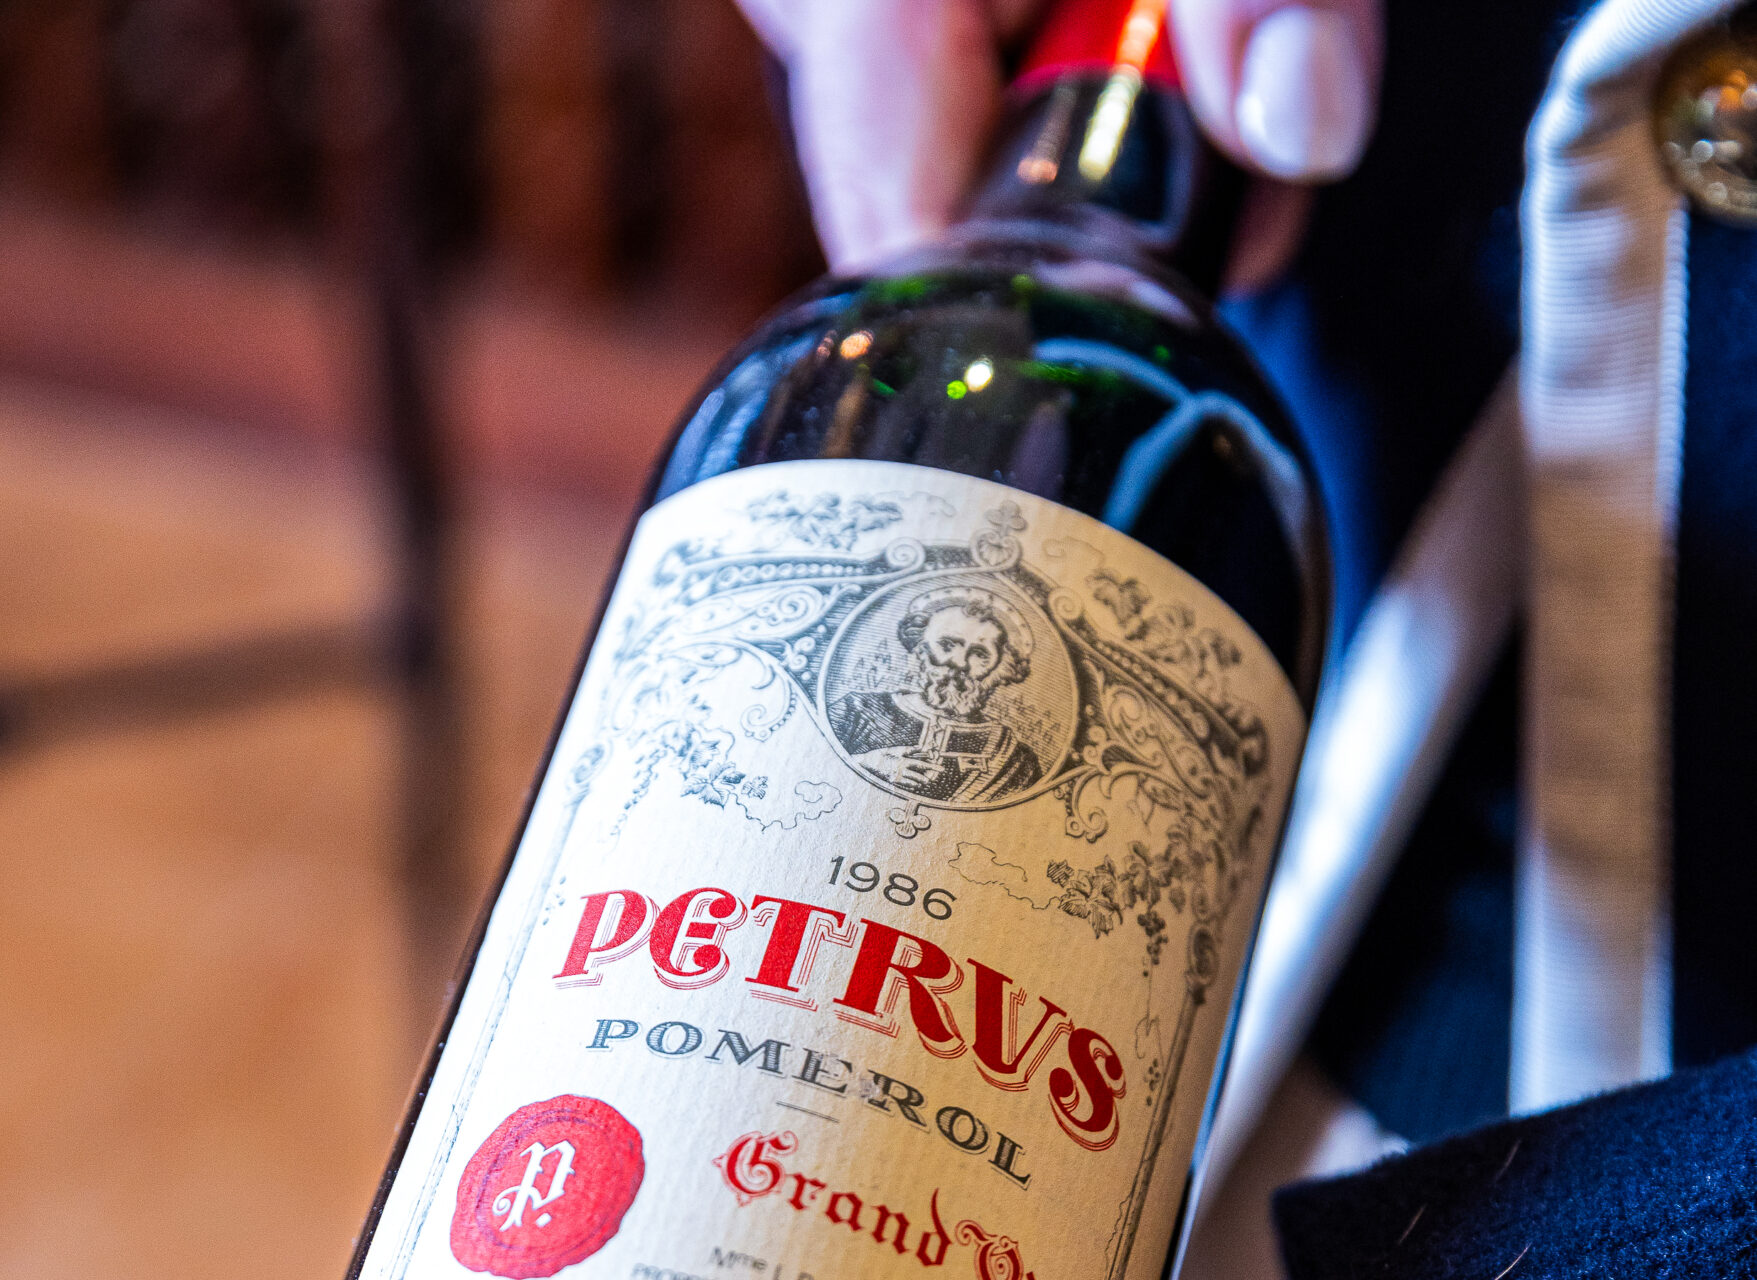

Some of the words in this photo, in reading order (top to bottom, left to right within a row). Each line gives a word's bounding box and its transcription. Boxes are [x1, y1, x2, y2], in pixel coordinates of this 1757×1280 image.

[828, 855, 957, 921] 1986
[586, 1019, 1031, 1190] POMEROL
[713, 1130, 952, 1267] Grand
